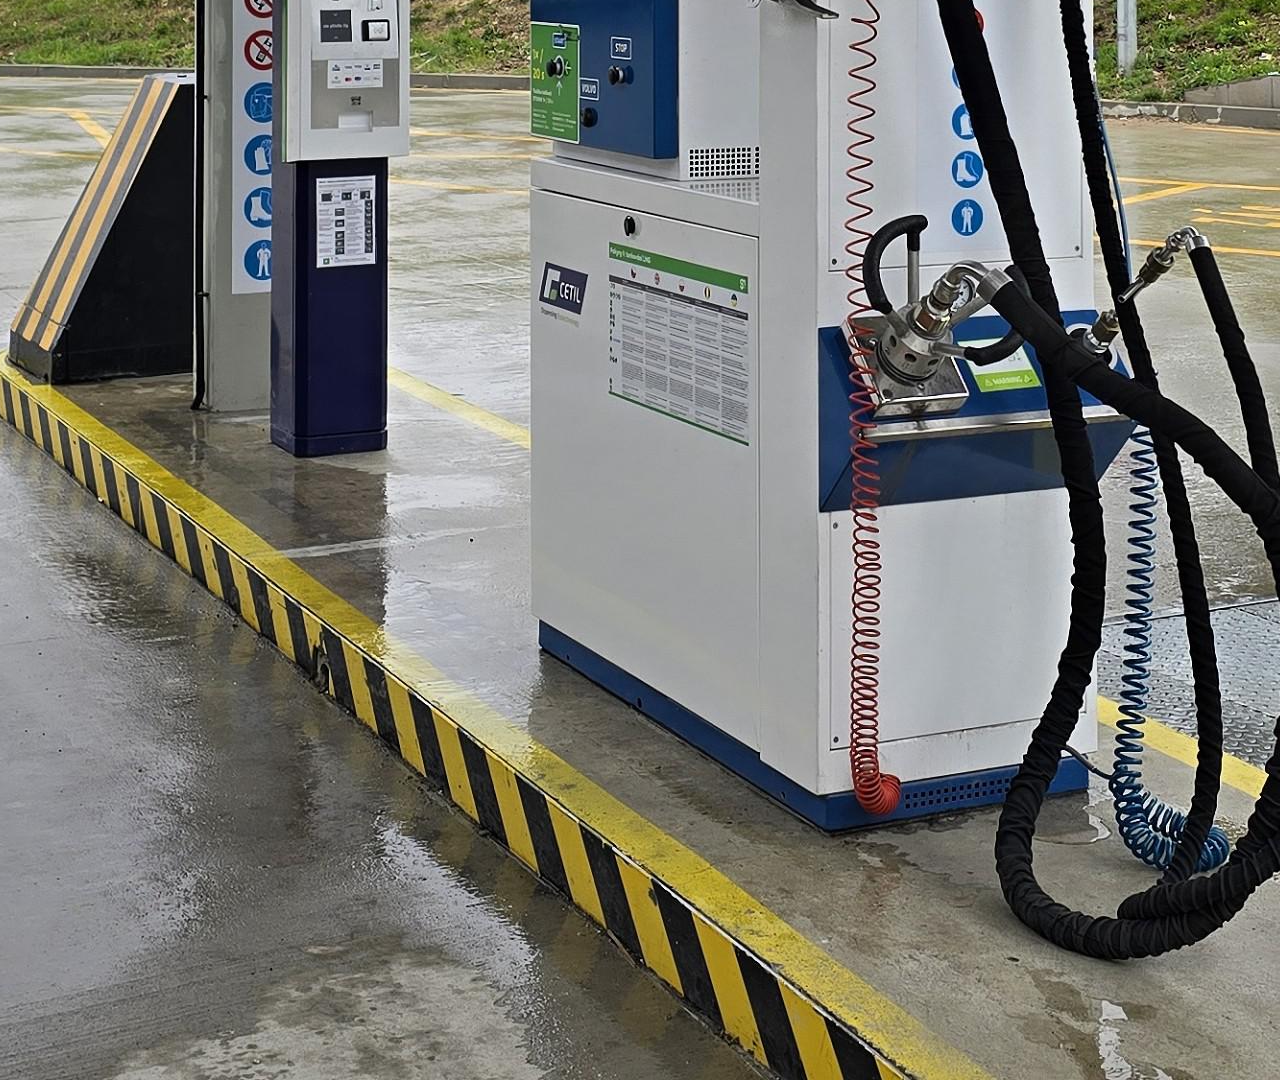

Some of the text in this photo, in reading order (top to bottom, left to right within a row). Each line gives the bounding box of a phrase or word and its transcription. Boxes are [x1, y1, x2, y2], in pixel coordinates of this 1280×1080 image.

[615, 42, 628, 53] STOP
[581, 83, 597, 94] VOLVO
[559, 282, 581, 303] CETIL
